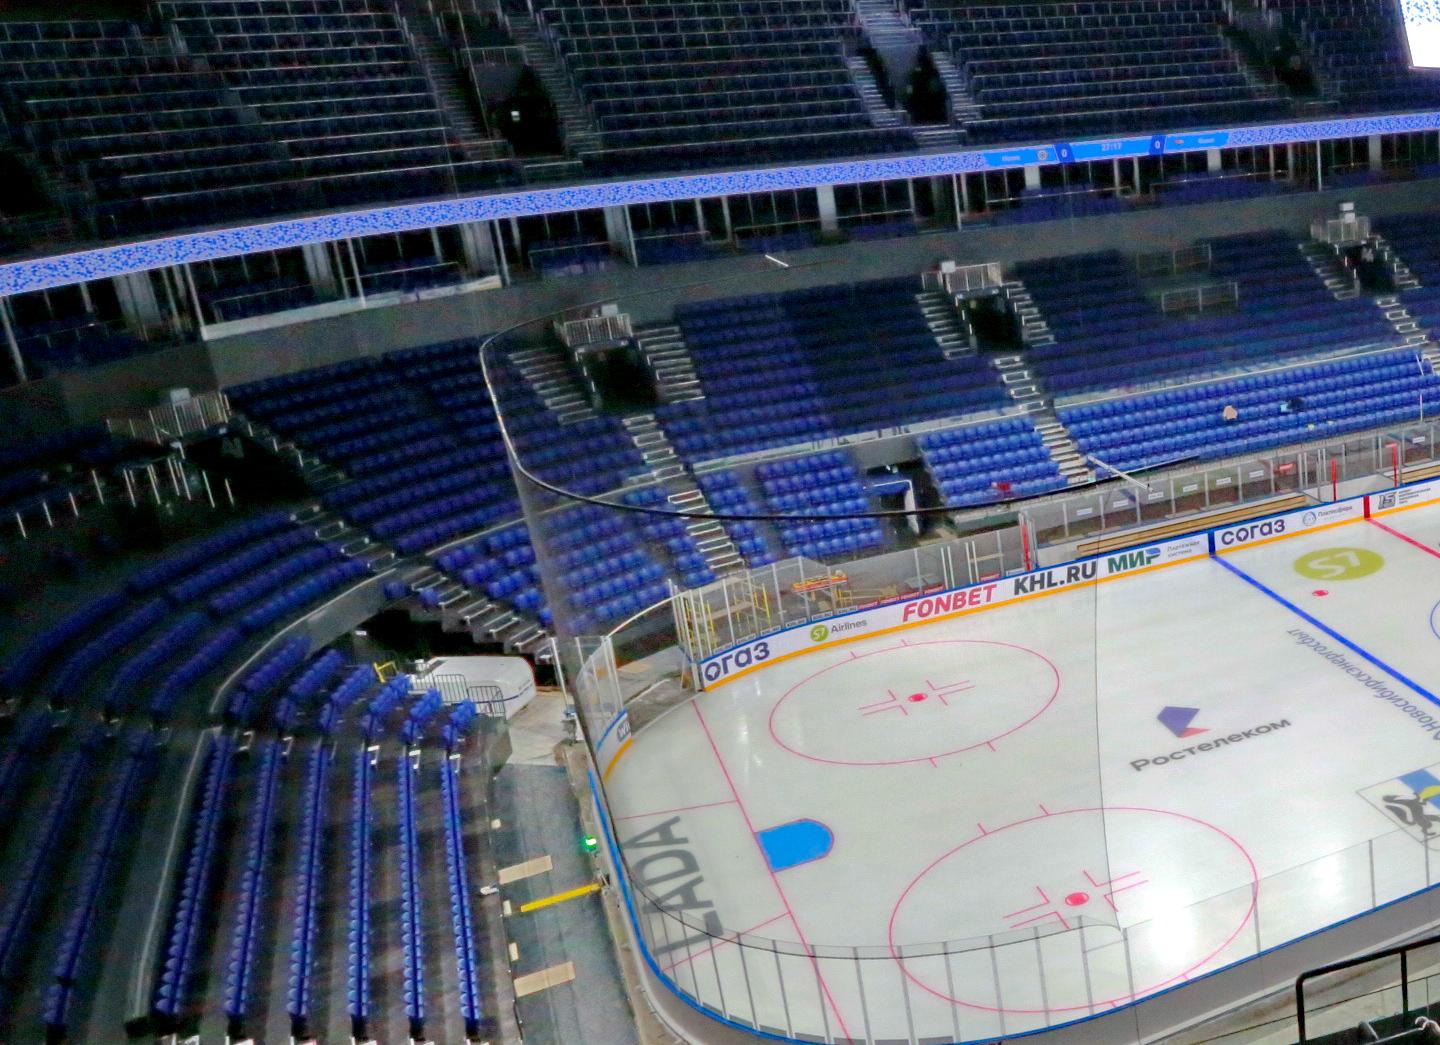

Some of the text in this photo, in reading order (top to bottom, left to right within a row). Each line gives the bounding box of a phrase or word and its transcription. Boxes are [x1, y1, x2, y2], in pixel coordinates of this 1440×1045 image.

[1013, 561, 1097, 596] KHL.RU
[1107, 547, 1161, 574] МИР
[902, 584, 997, 622] FONBET
[830, 618, 868, 634] Airlines
[1129, 719, 1292, 772] Ростелеком
[623, 815, 725, 956] LADA
